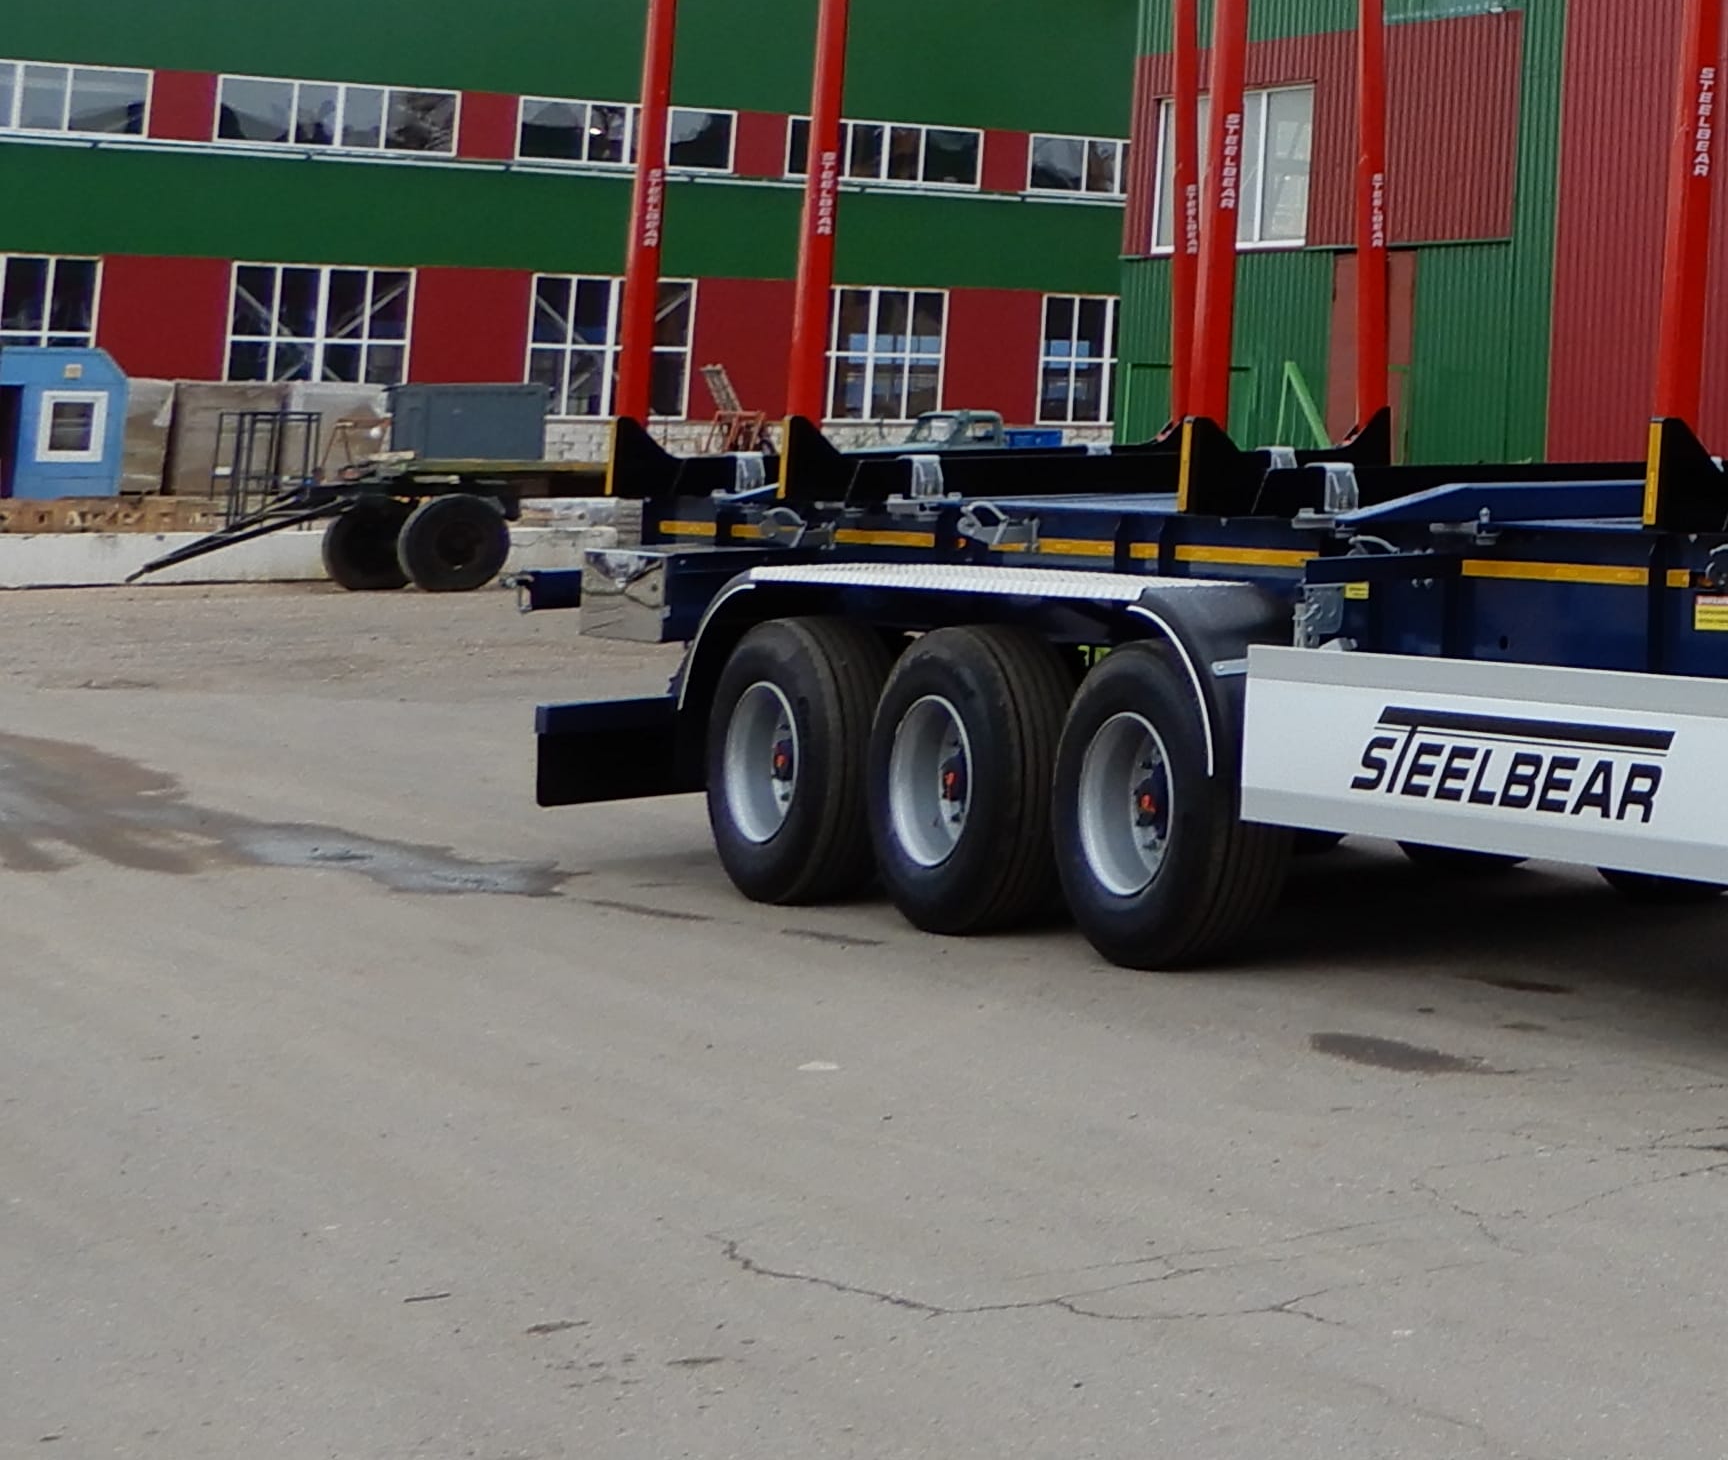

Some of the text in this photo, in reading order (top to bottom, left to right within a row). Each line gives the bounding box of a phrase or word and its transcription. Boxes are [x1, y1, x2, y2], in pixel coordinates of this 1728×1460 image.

[1219, 113, 1241, 209] STEELBEAR
[1693, 67, 1715, 177] STEELBEAR
[1350, 706, 1676, 823] STEELBEAR
